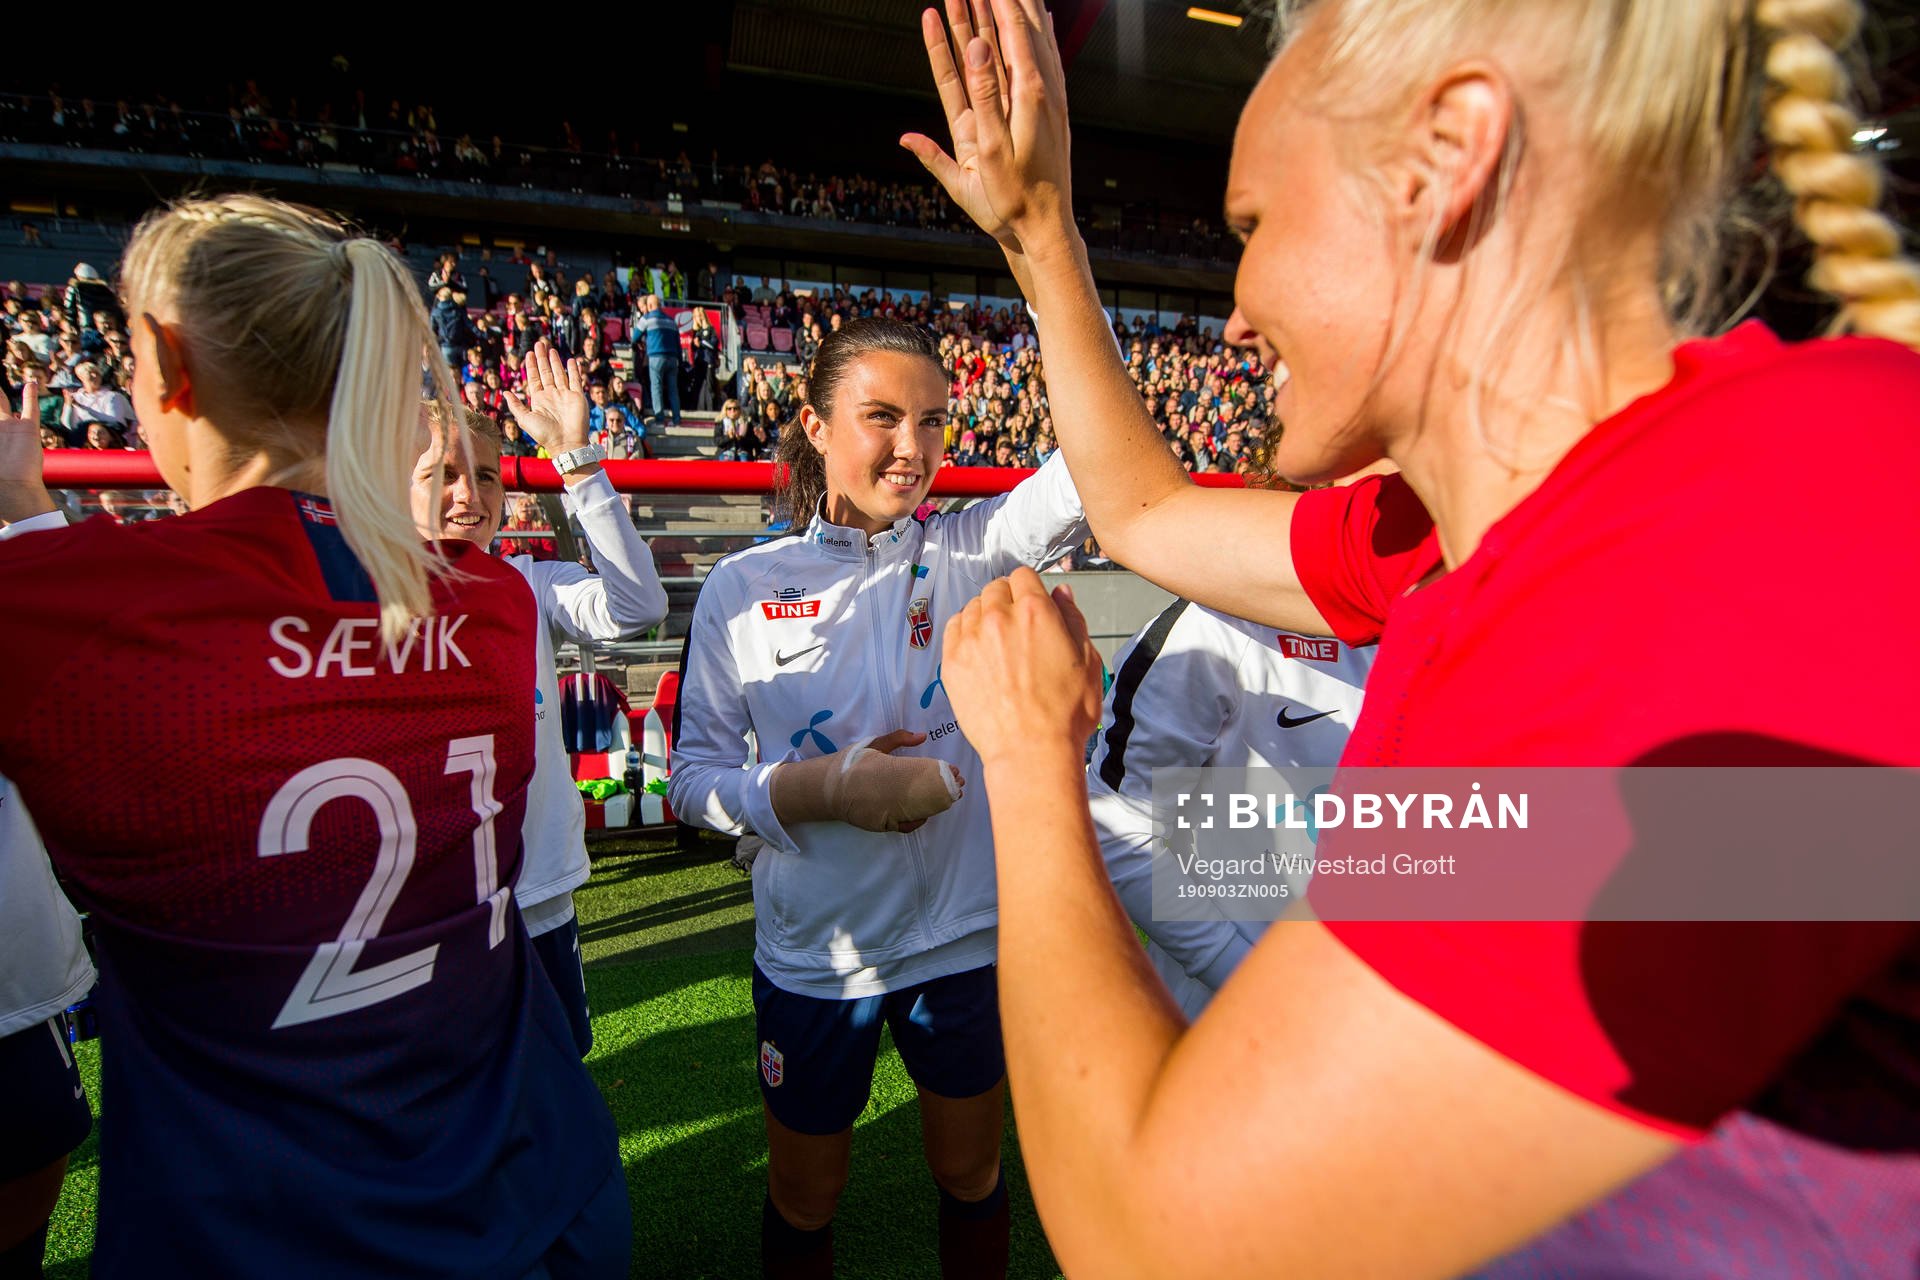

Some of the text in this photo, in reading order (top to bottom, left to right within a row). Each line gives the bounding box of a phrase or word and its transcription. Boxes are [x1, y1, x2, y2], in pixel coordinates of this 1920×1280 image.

[823, 536, 852, 548] telenor
[767, 602, 815, 617] TINE
[267, 614, 472, 679] SÆVIK
[1285, 638, 1334, 658] TINE
[258, 734, 510, 1030] 21
